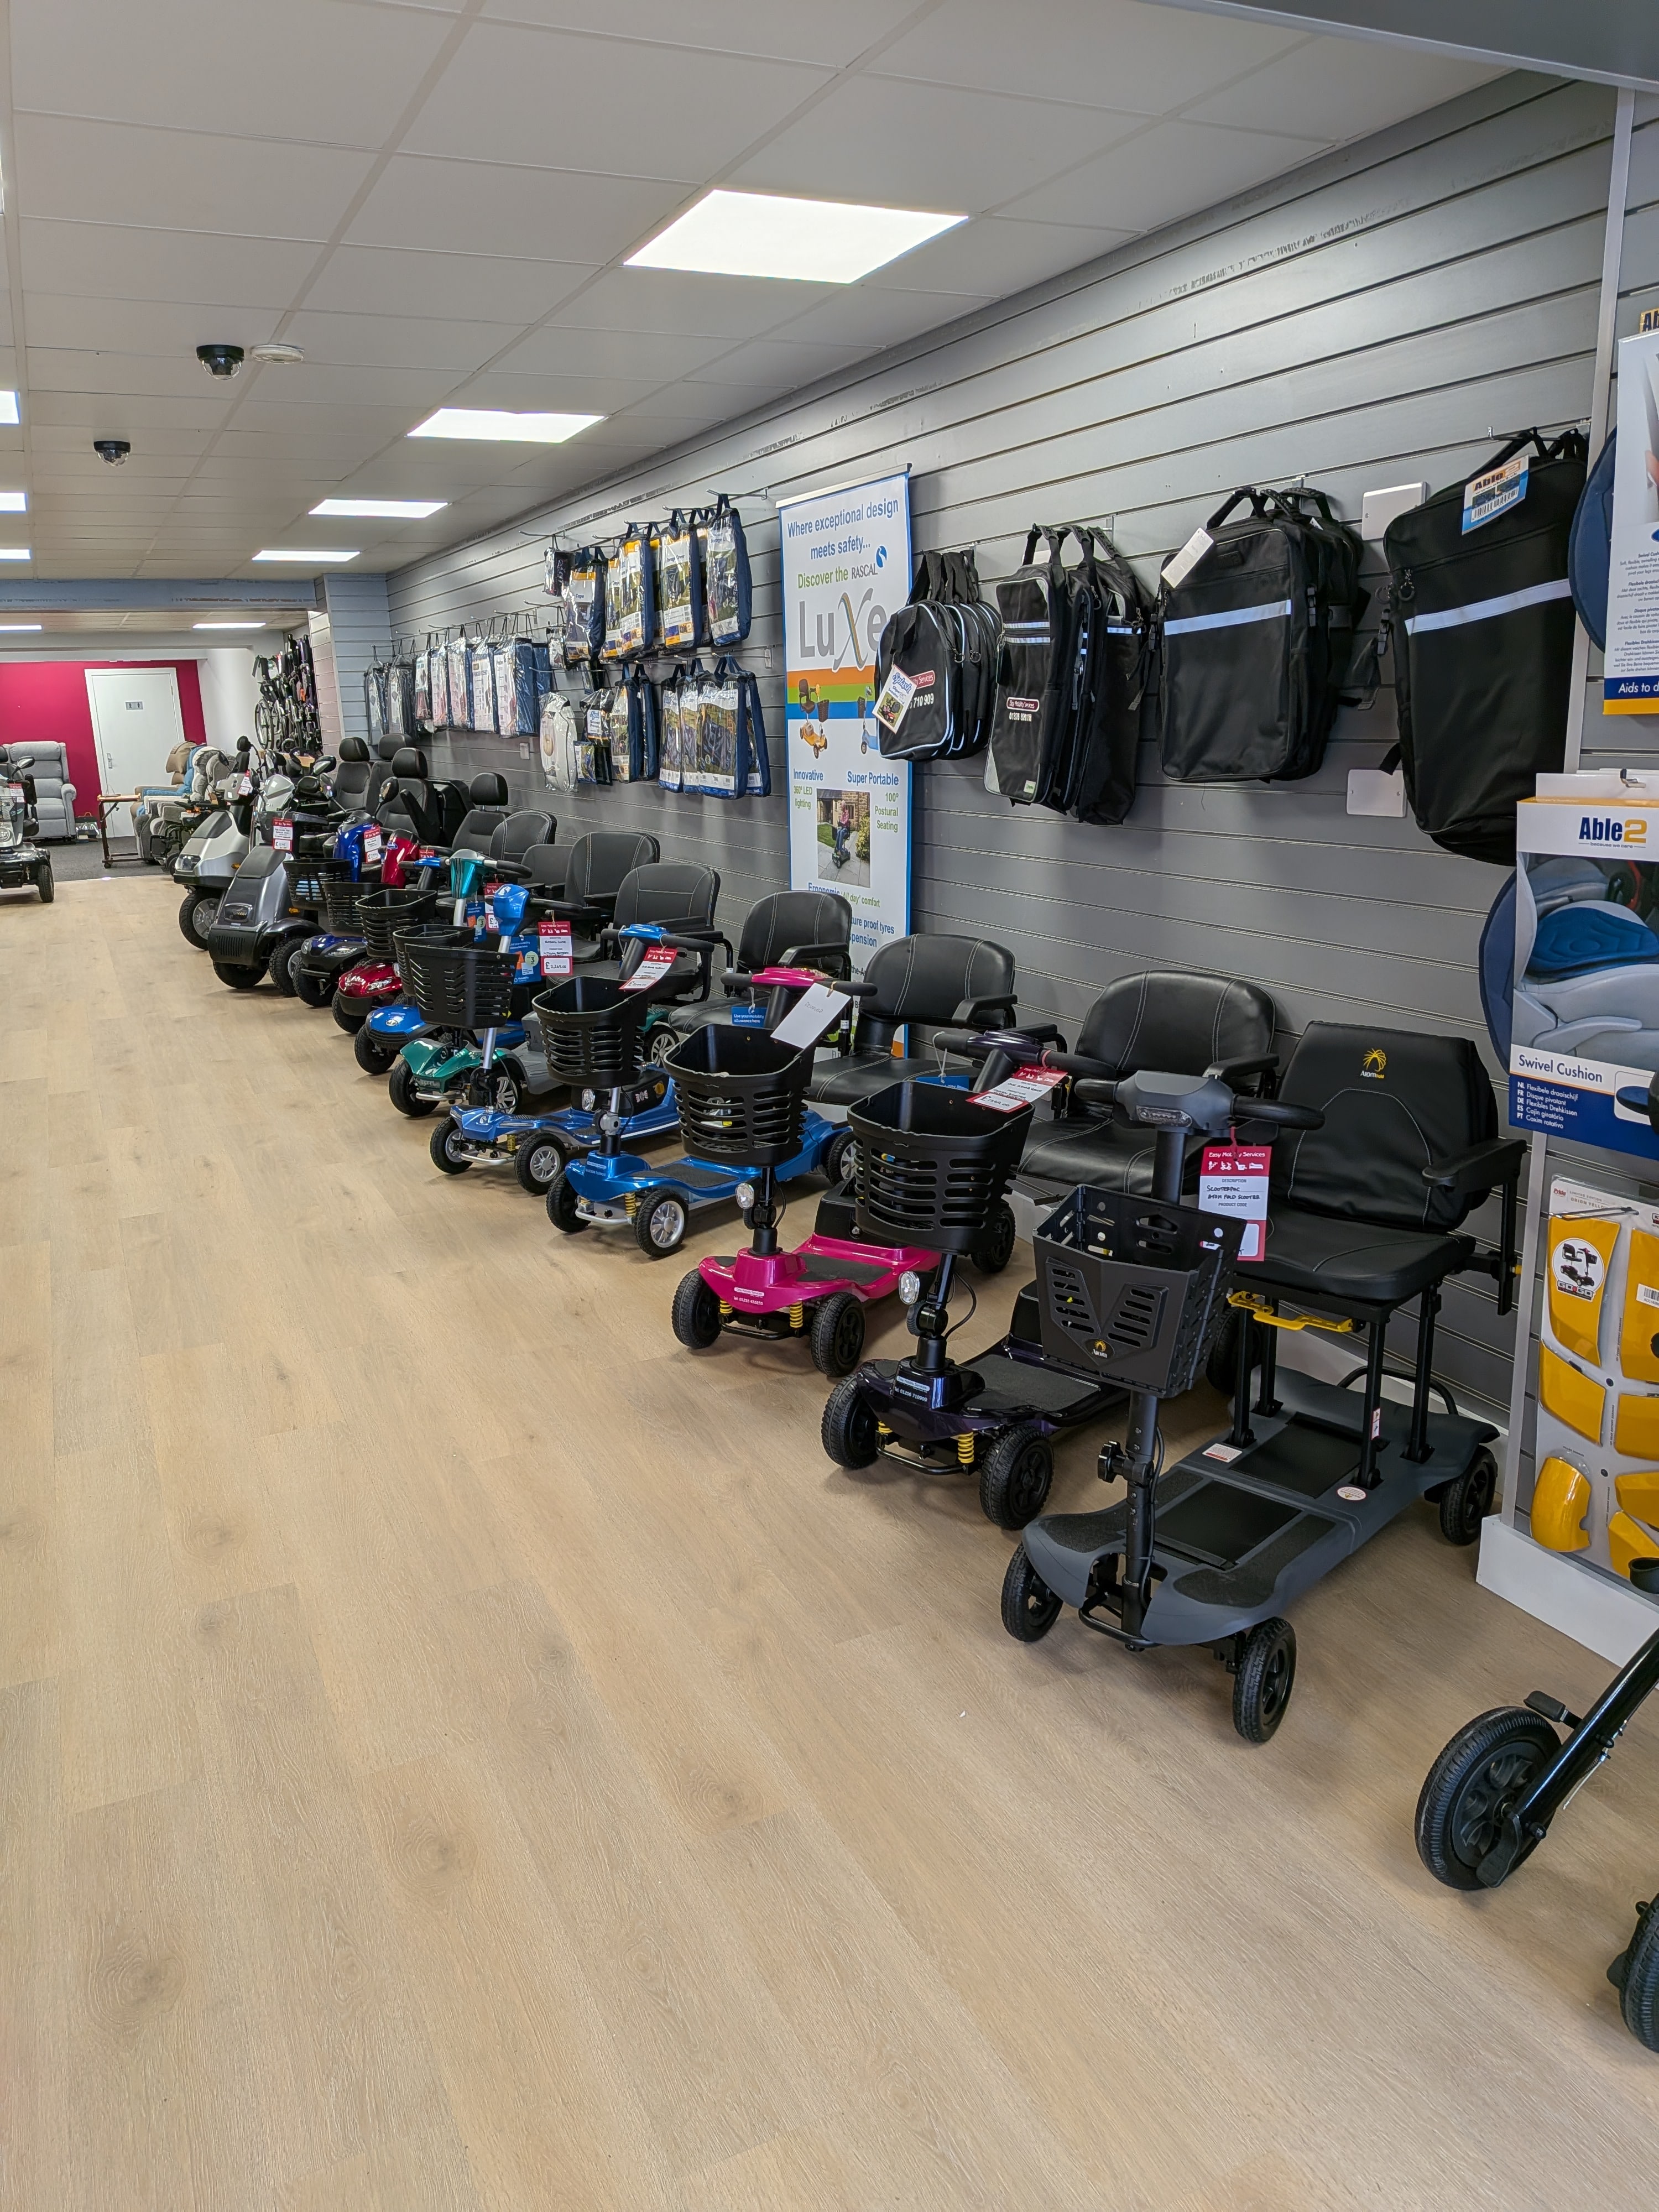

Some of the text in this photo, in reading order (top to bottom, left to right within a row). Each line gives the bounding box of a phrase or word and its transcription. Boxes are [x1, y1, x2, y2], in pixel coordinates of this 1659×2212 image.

[787, 498, 899, 538] Where exceptional design
[811, 541, 836, 560] meets
[797, 563, 878, 589] Discover the RASCAL
[892, 672, 912, 694] Splash
[1618, 681, 1639, 693] Aids
[1641, 682, 1651, 692] to
[913, 695, 922, 708] 710
[924, 692, 934, 706] 909
[793, 768, 899, 786] Innovative Super Portable
[803, 786, 813, 795] LED
[795, 799, 811, 810] lighting
[875, 805, 899, 817] Postural
[877, 820, 898, 833] Seating
[1578, 817, 1647, 843] Able2
[861, 897, 880, 908] comfort
[863, 919, 895, 935] proof tyres
[1518, 1054, 1603, 1083] Swivel Cushion
[1526, 1083, 1550, 1094] Flexibele
[1550, 1089, 1579, 1102] draaischijf
[1526, 1091, 1544, 1100] Disque
[1545, 1096, 1566, 1105] pivotant
[1526, 1099, 1548, 1110] Flexibles
[1550, 1104, 1578, 1117] Drehkissen
[1543, 1120, 1564, 1129] rotativo
[1553, 1188, 1567, 1196] Pride
[1571, 1197, 1587, 1206] ORION
